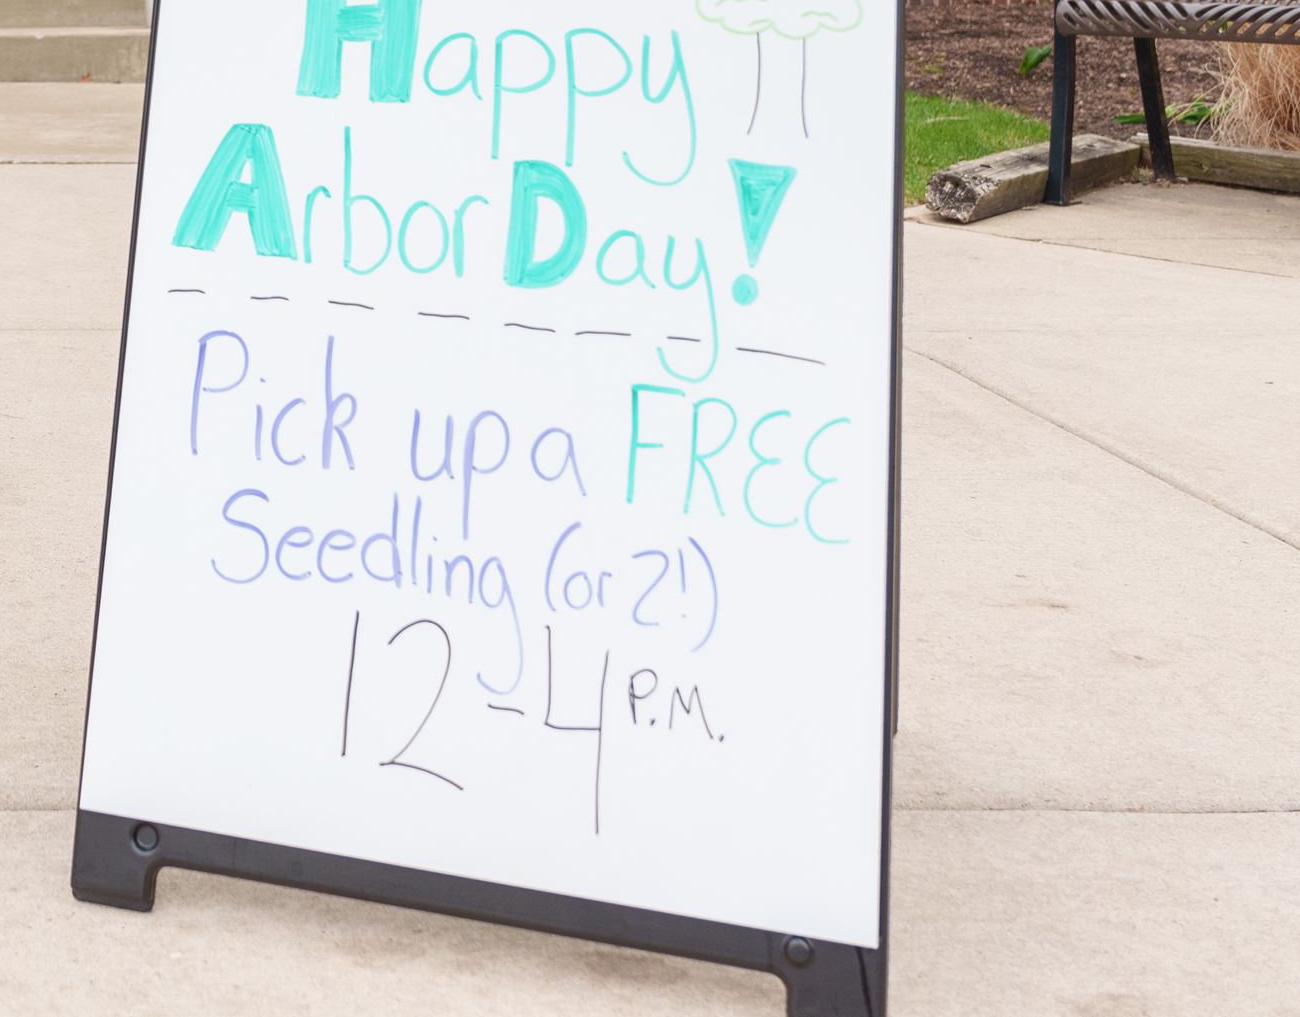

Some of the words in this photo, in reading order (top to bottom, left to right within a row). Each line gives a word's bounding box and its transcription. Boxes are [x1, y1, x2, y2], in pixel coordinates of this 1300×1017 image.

[172, 123, 490, 279] Arbor
[503, 158, 798, 384] Day!
[191, 330, 358, 470] Pick
[411, 409, 511, 541] up
[530, 427, 587, 497] a
[626, 383, 851, 544] FREE
[211, 487, 524, 695] Seedling
[545, 521, 613, 611] (or
[632, 536, 718, 653] 2!)
[628, 668, 725, 743] P.M.
